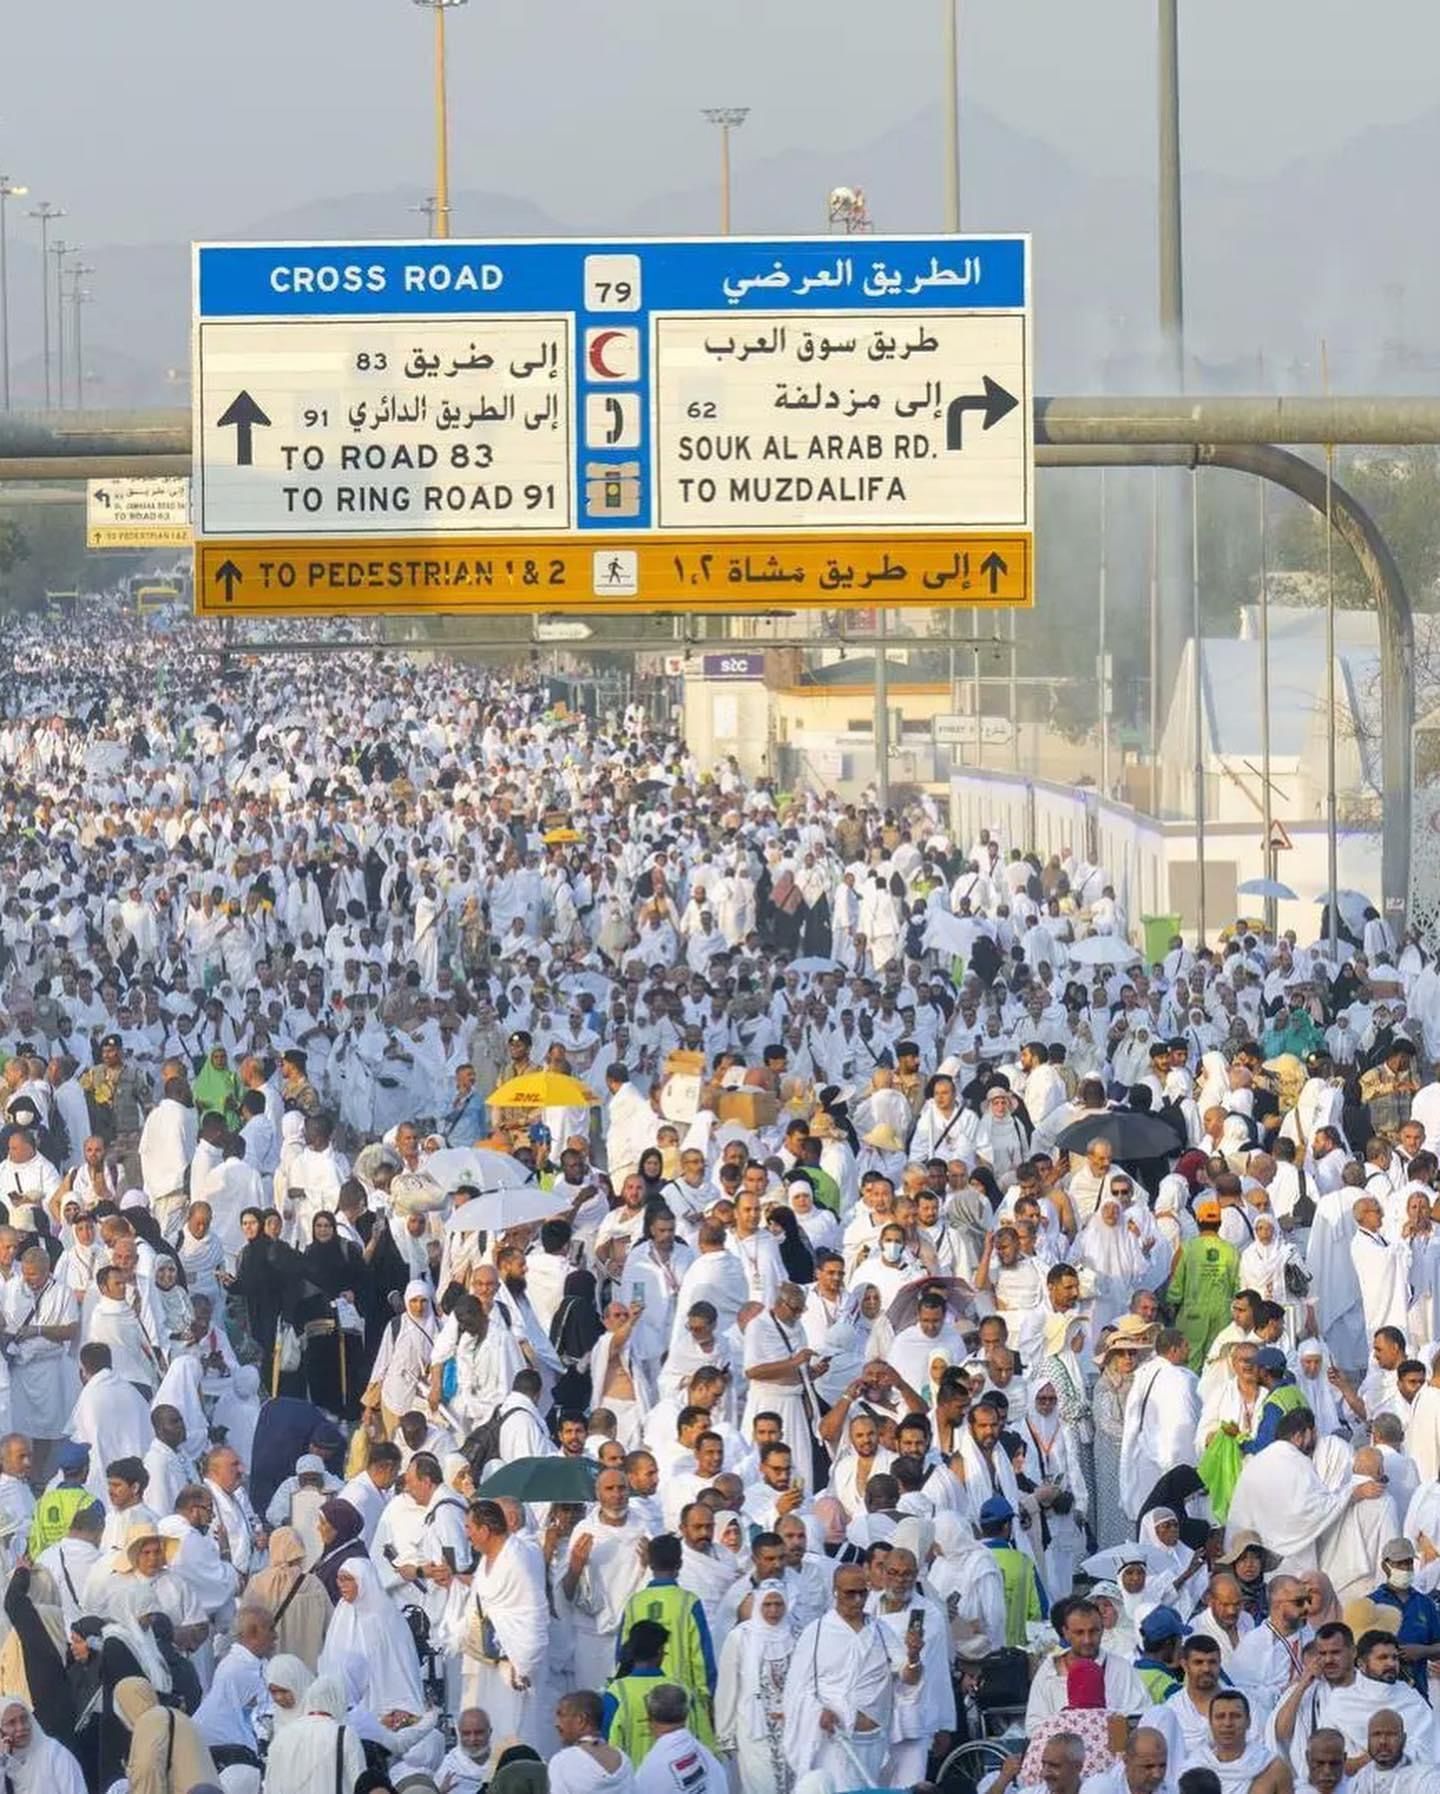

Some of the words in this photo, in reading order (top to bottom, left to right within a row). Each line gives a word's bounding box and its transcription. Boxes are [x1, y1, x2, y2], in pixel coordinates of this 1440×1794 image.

[270, 265, 386, 293] CROSS
[404, 264, 503, 291] ROAD
[722, 258, 853, 304] العرضي
[863, 257, 981, 297] الطريق
[595, 282, 631, 303] 79
[704, 327, 786, 362] العرب
[796, 332, 857, 363] سوق
[867, 327, 939, 362] طريق
[356, 352, 388, 371] 83
[509, 341, 558, 379] إلى
[348, 394, 427, 433] الدائري
[435, 394, 515, 431] الطريق
[524, 393, 558, 431] إلى
[687, 401, 717, 419] 62
[774, 383, 881, 418] مزدلفة
[894, 381, 942, 420] إلى
[303, 409, 328, 428] 91
[280, 445, 324, 471] TO
[341, 445, 438, 471] ROAD
[450, 443, 494, 469] 83
[678, 435, 752, 461] SOUK
[762, 435, 799, 460] AL
[808, 434, 883, 460] ARAB
[894, 434, 938, 460] RD.
[283, 487, 323, 513] TO
[337, 486, 410, 512] RING
[424, 485, 513, 511] ROAD
[524, 484, 554, 510] 91
[679, 478, 717, 503] TO
[730, 477, 907, 503] MUZDALIFA
[114, 512, 127, 520] TO
[129, 512, 156, 520] ROAD
[259, 562, 297, 588] TO
[308, 560, 492, 588] PEDESTRIAN
[727, 555, 806, 584] مشاة
[819, 554, 908, 591] طريق
[922, 552, 971, 590] إلى
[720, 657, 749, 673] stc
